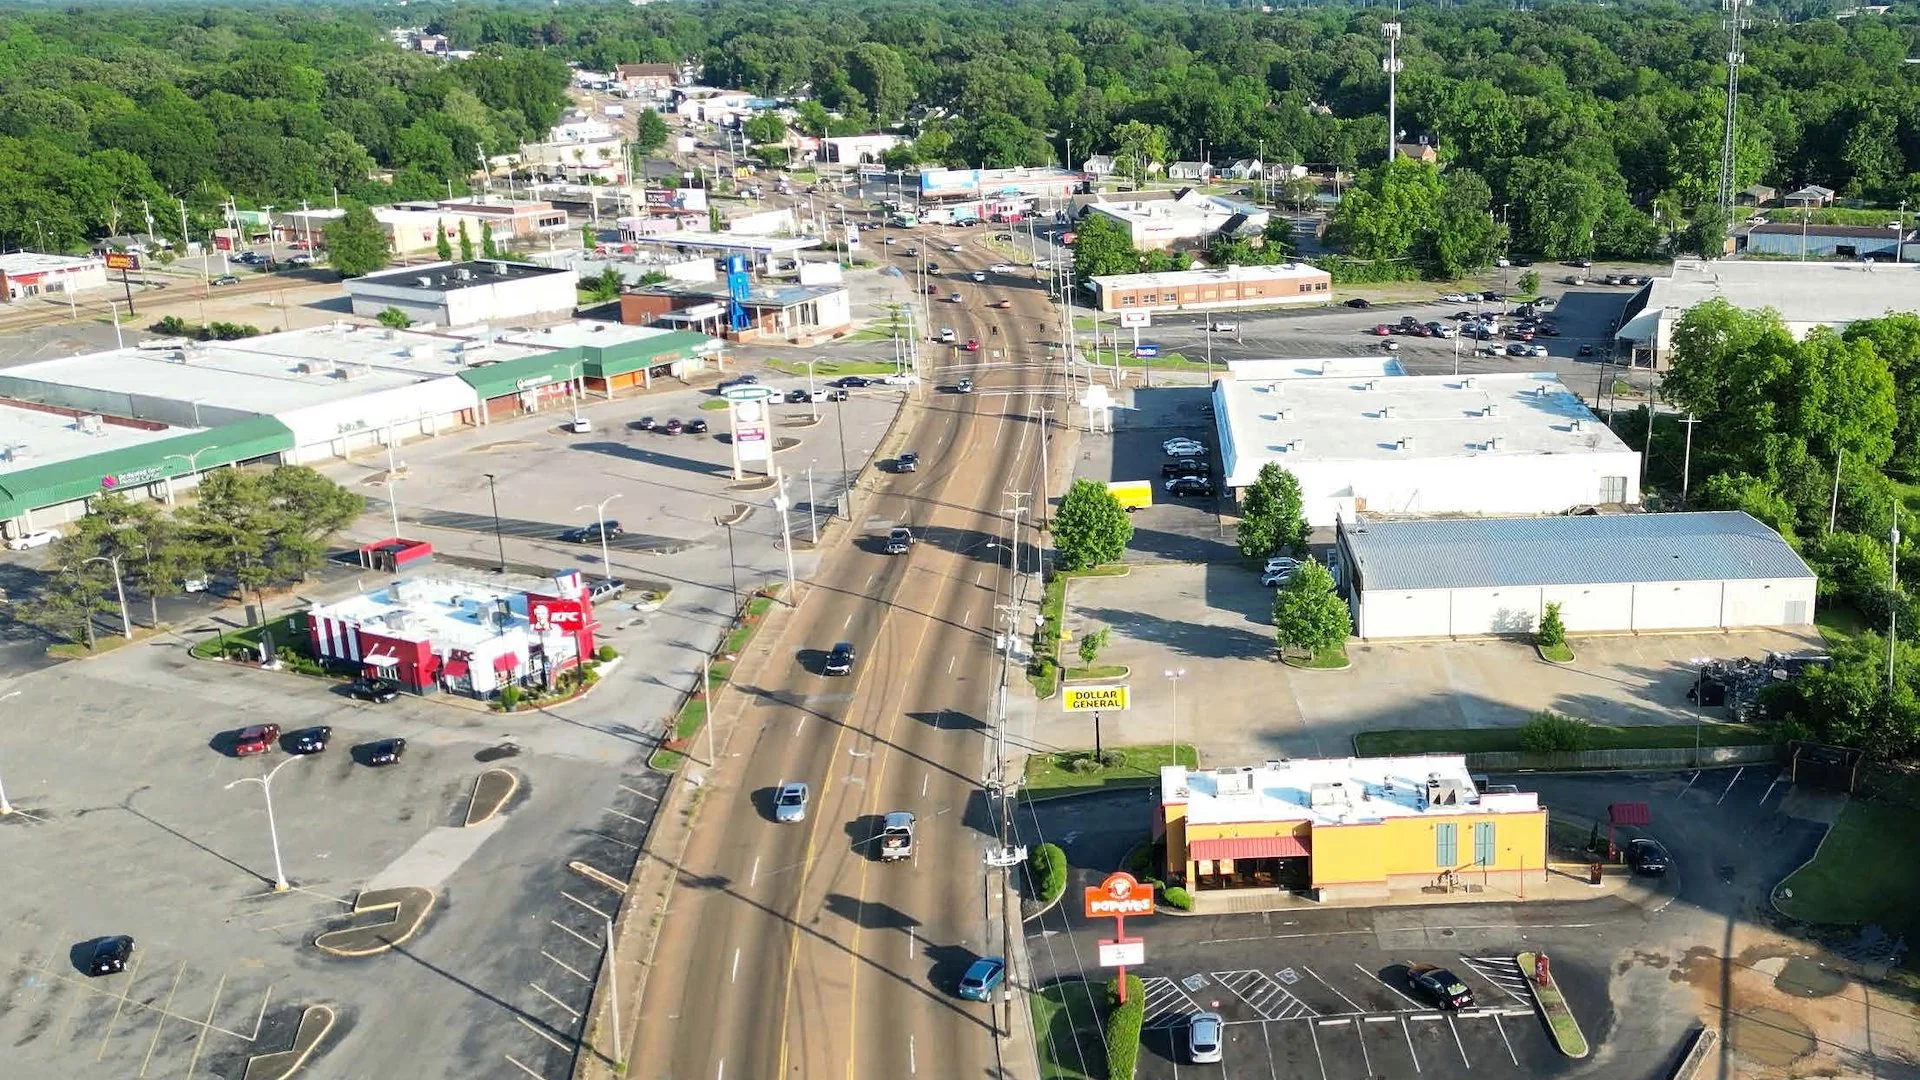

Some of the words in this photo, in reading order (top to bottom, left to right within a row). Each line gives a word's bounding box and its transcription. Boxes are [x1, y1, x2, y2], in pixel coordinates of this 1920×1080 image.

[550, 611, 578, 622] KFC
[451, 648, 475, 661] KFC
[1075, 690, 1117, 700] DOLLAR
[1073, 700, 1121, 709] GENERAL
